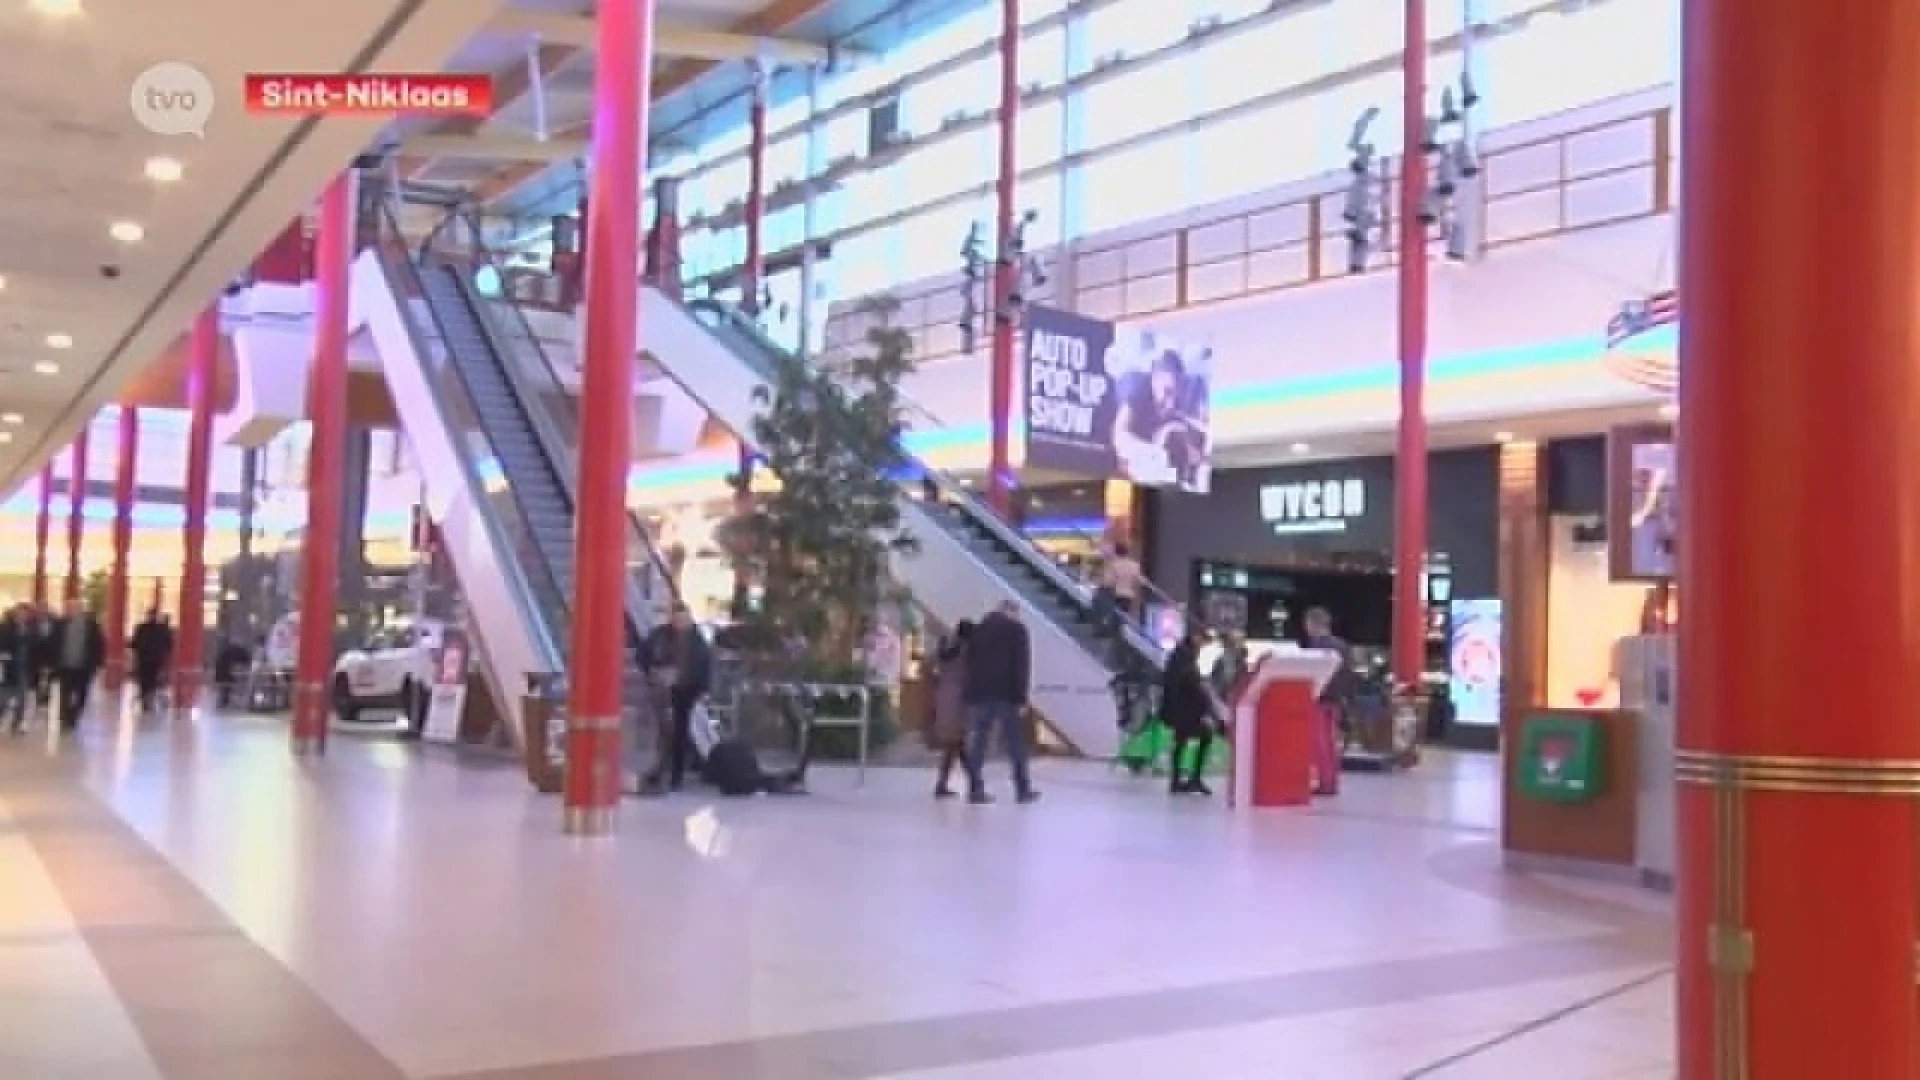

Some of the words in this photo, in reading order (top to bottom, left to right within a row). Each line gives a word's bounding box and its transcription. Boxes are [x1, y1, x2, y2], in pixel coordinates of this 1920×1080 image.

[1031, 328, 1088, 371] AUTO
[1031, 362, 1108, 404] POP-UP
[1031, 396, 1094, 433] SHOW
